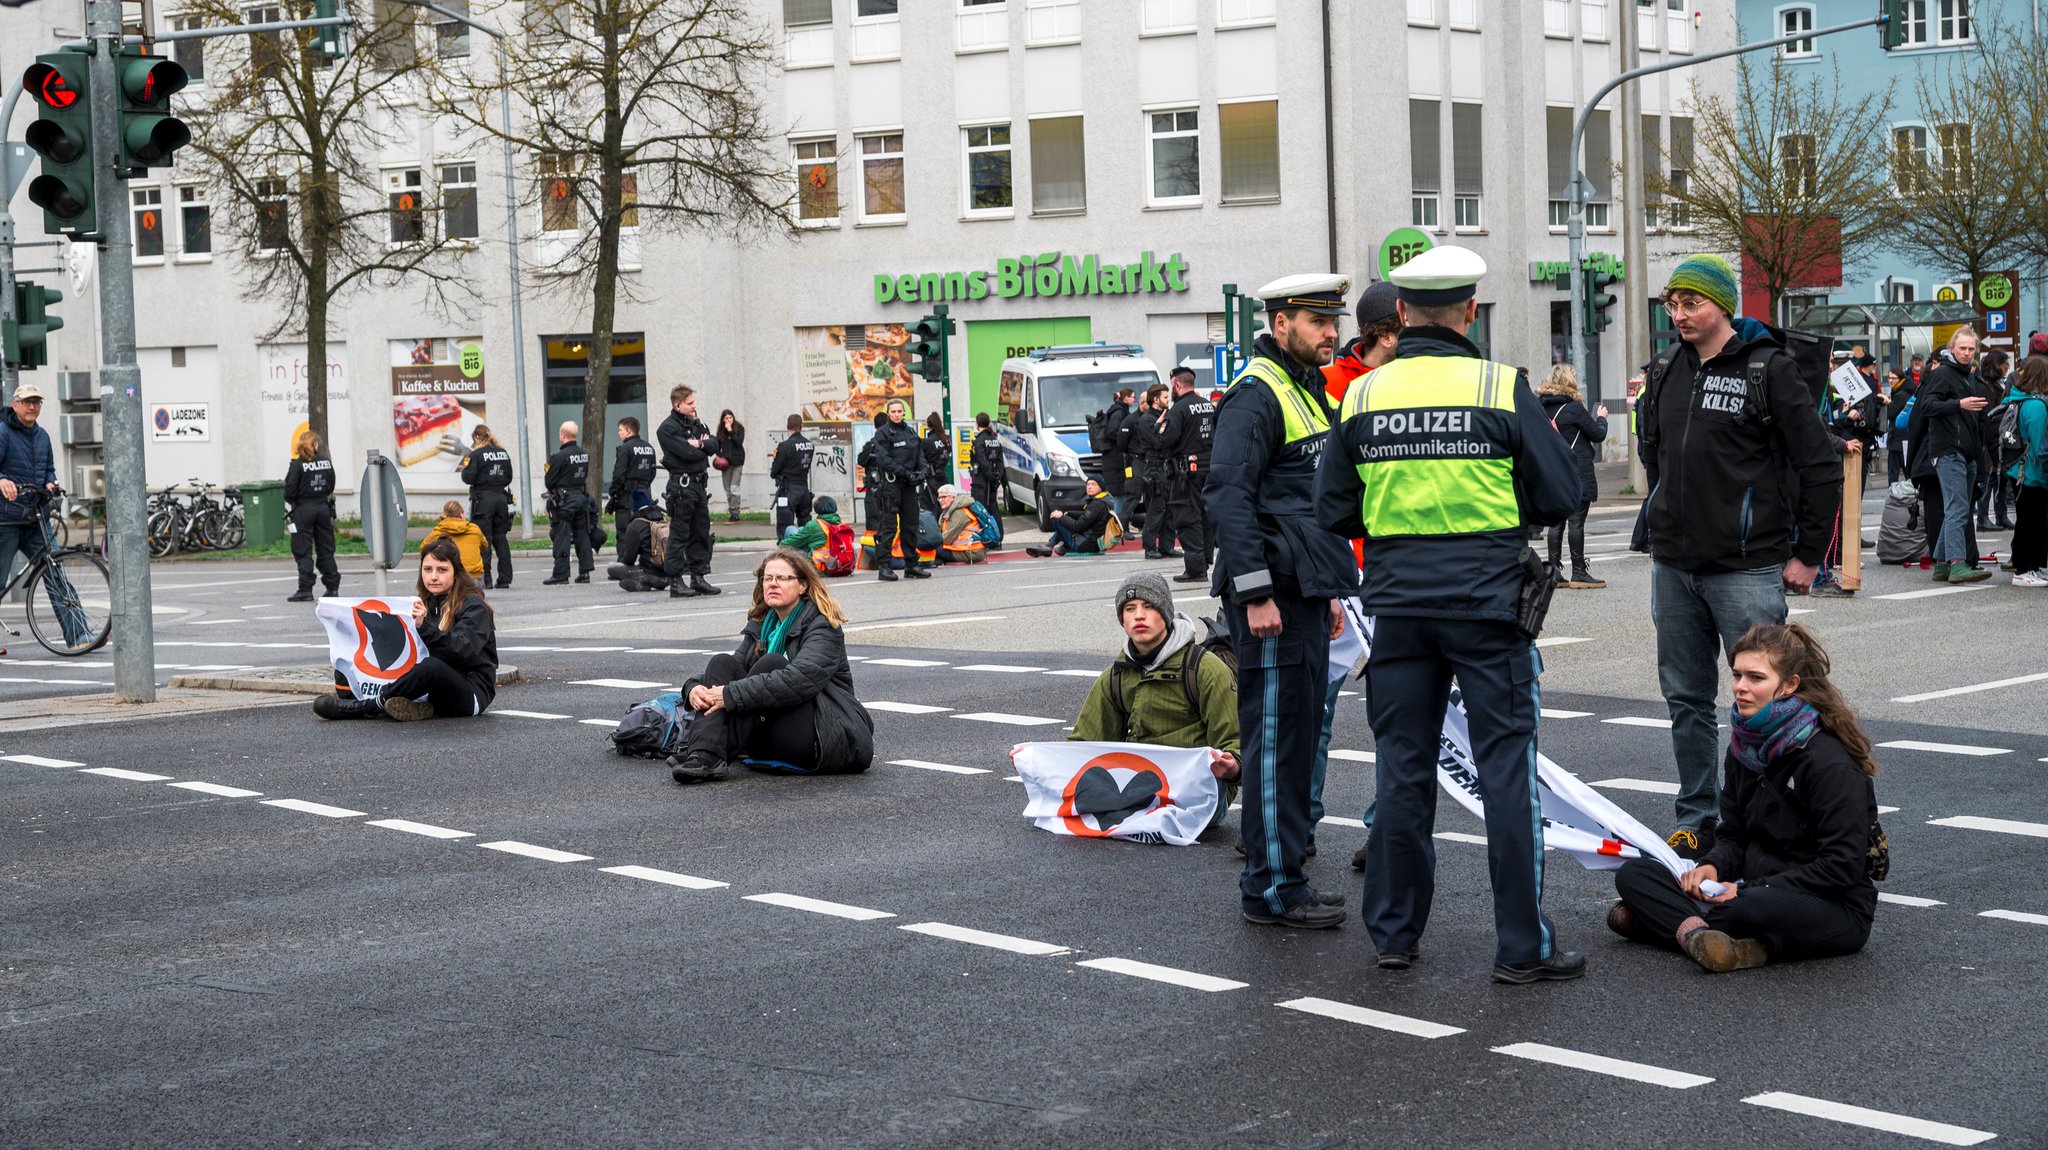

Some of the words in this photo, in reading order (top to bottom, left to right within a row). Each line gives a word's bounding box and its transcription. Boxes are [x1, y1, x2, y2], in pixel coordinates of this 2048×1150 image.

[1536, 261, 1571, 281] Denn
[1986, 287, 2005, 300] Bio
[1991, 314, 2004, 329] P
[270, 360, 286, 379] in
[464, 357, 480, 370] Bio
[401, 380, 432, 393] Kaffee
[433, 380, 442, 391] &
[443, 378, 479, 391] Kuchen
[812, 386, 838, 394] vegetarisch
[1842, 375, 1857, 392] JETZT
[1701, 392, 1745, 414] KILLS!
[171, 408, 206, 421] LADEZONE
[1373, 411, 1472, 436] POLIZEI
[1359, 439, 1491, 459] Kommunikation
